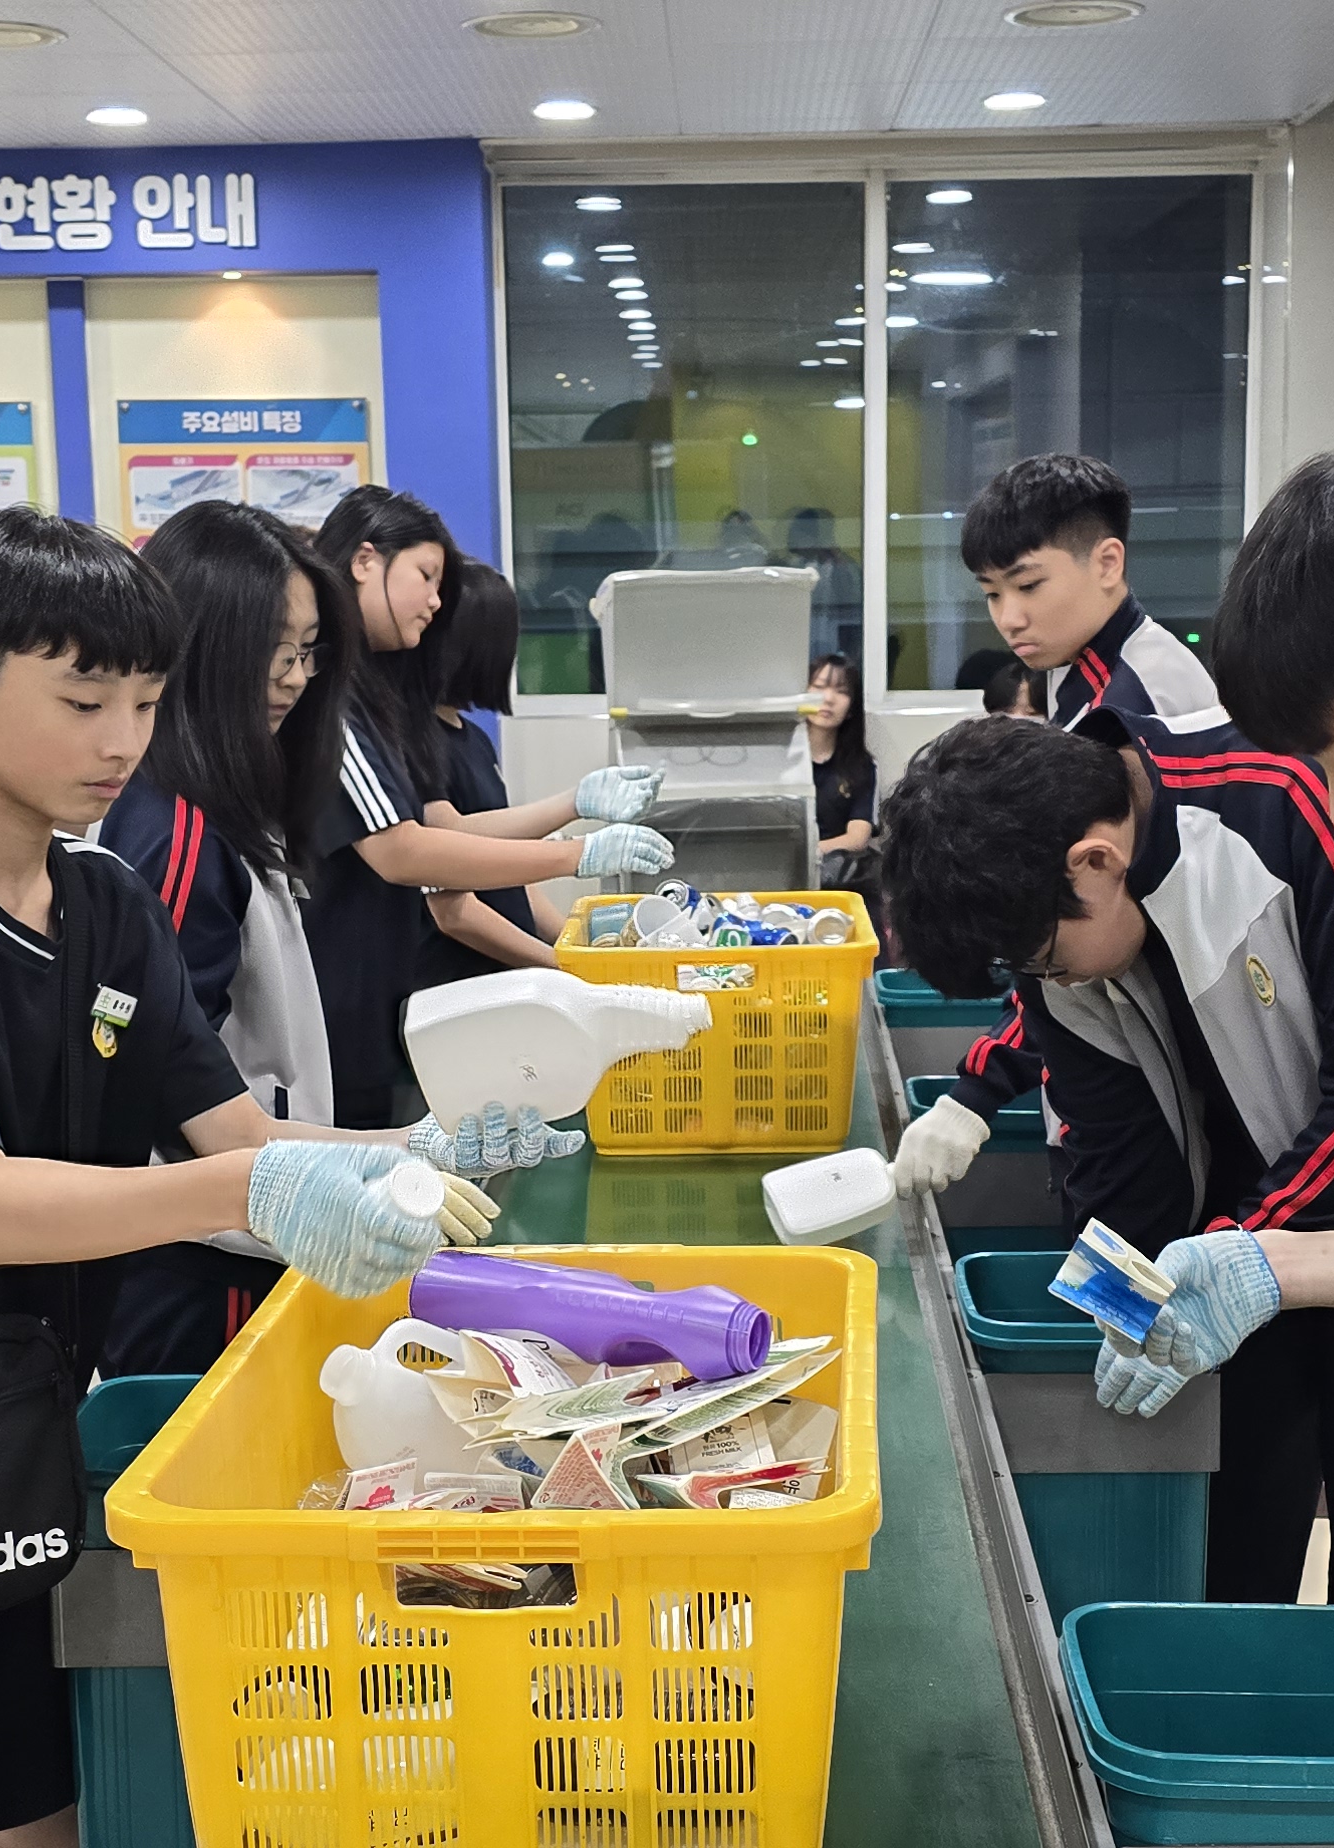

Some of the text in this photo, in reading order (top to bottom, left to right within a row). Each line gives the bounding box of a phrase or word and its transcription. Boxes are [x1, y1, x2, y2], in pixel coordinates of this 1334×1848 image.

[133, 172, 257, 249] 안내
[182, 410, 303, 434] 주요설비 특징
[701, 1446, 743, 1458] FRESH MILK
[717, 1440, 740, 1449] 100%
